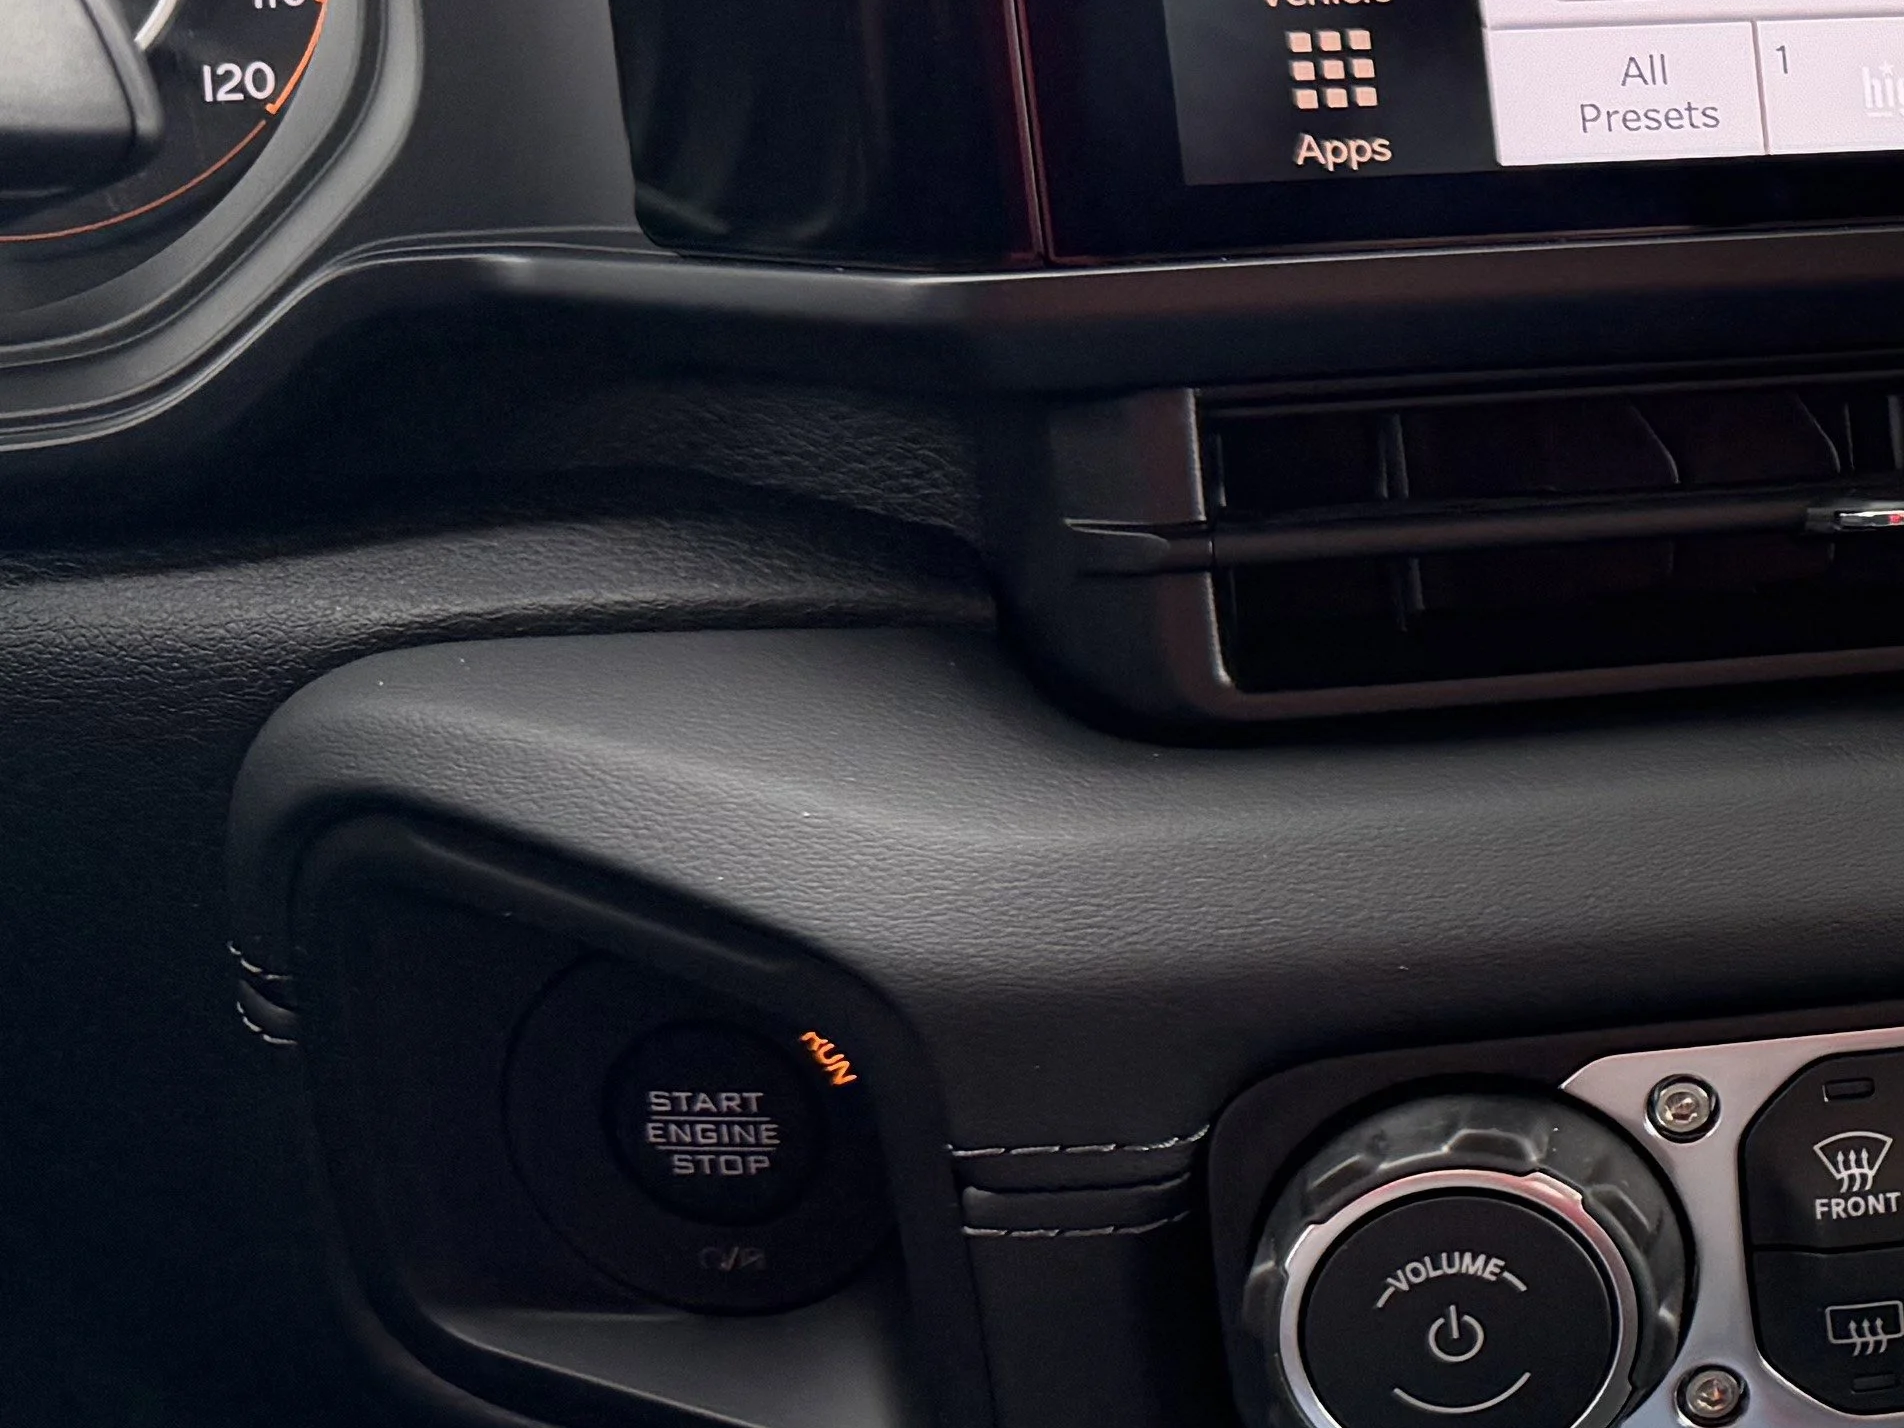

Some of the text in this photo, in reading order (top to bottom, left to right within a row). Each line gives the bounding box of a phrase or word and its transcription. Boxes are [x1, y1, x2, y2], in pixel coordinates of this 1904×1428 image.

[1621, 53, 1669, 87] All
[1773, 46, 1789, 74] 1
[203, 62, 275, 103] 120
[1579, 101, 1720, 134] Presets
[1296, 134, 1392, 172] Apps
[801, 1031, 857, 1086] RUN
[648, 1091, 764, 1113] START
[645, 1123, 781, 1145] ENGINE
[672, 1155, 770, 1175] STOP
[1815, 1191, 1901, 1220] FRONT
[1390, 1252, 1505, 1294] VOLUME
